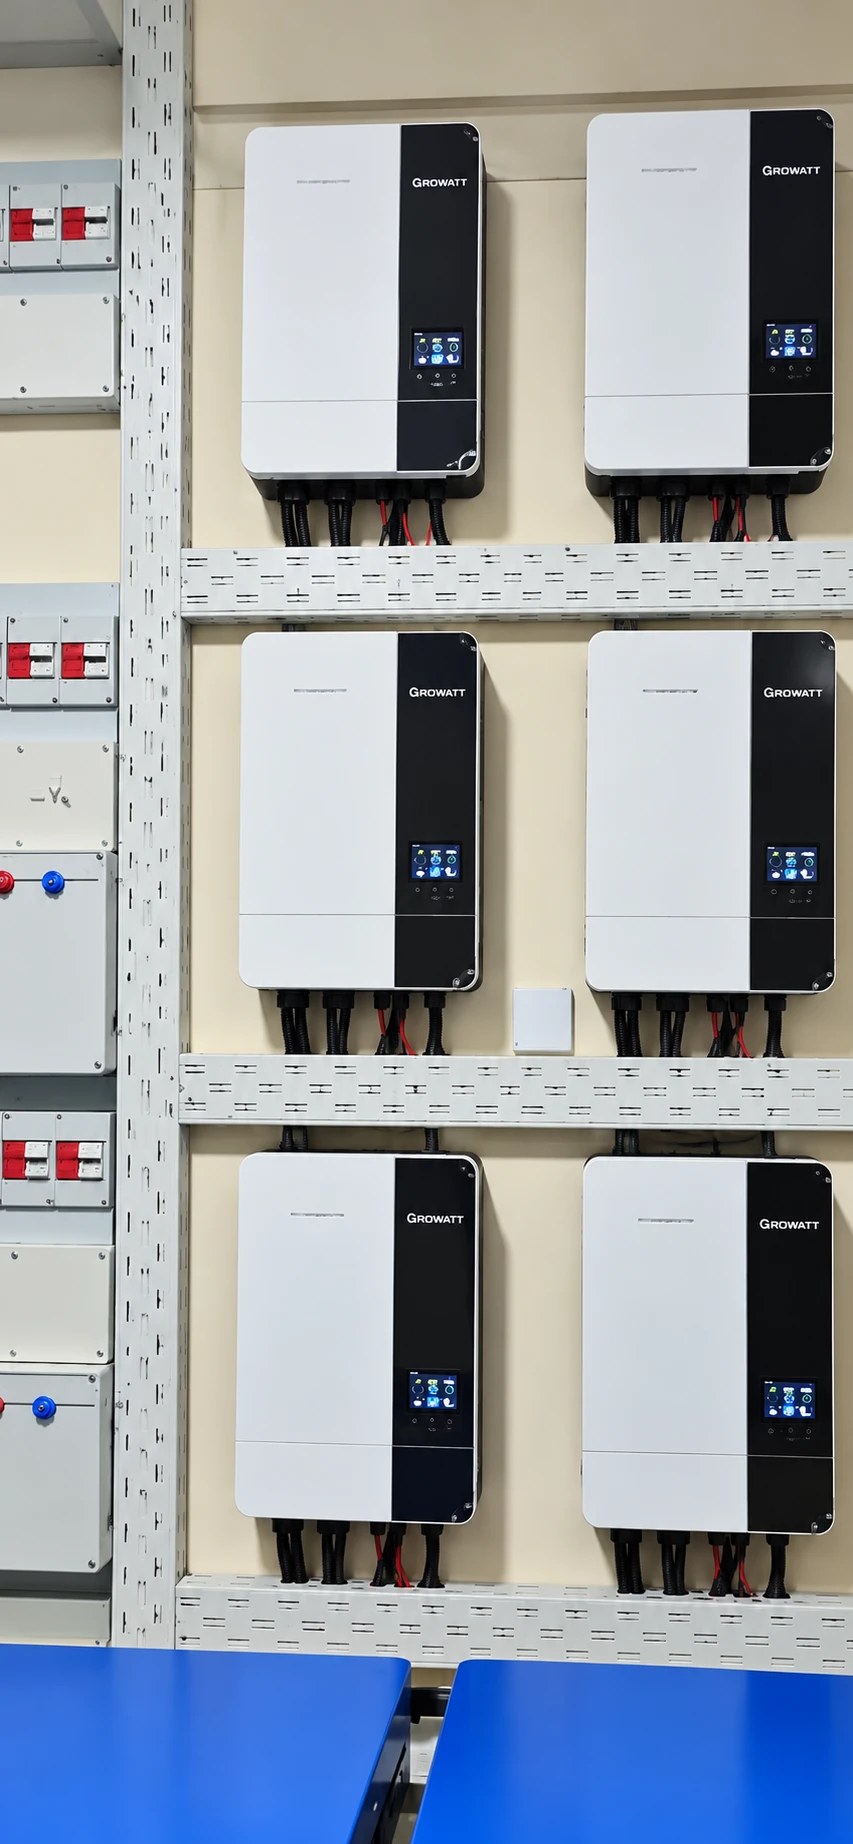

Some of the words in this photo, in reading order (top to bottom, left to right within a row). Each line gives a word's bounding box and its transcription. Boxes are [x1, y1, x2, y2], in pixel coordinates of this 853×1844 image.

[763, 165, 821, 176] GROWATT
[412, 177, 467, 188] GROWATT
[409, 686, 466, 697] GROWATT
[763, 687, 823, 698] GROWATT
[407, 1212, 465, 1223] GROWATT
[760, 1218, 820, 1230] GROWATT
